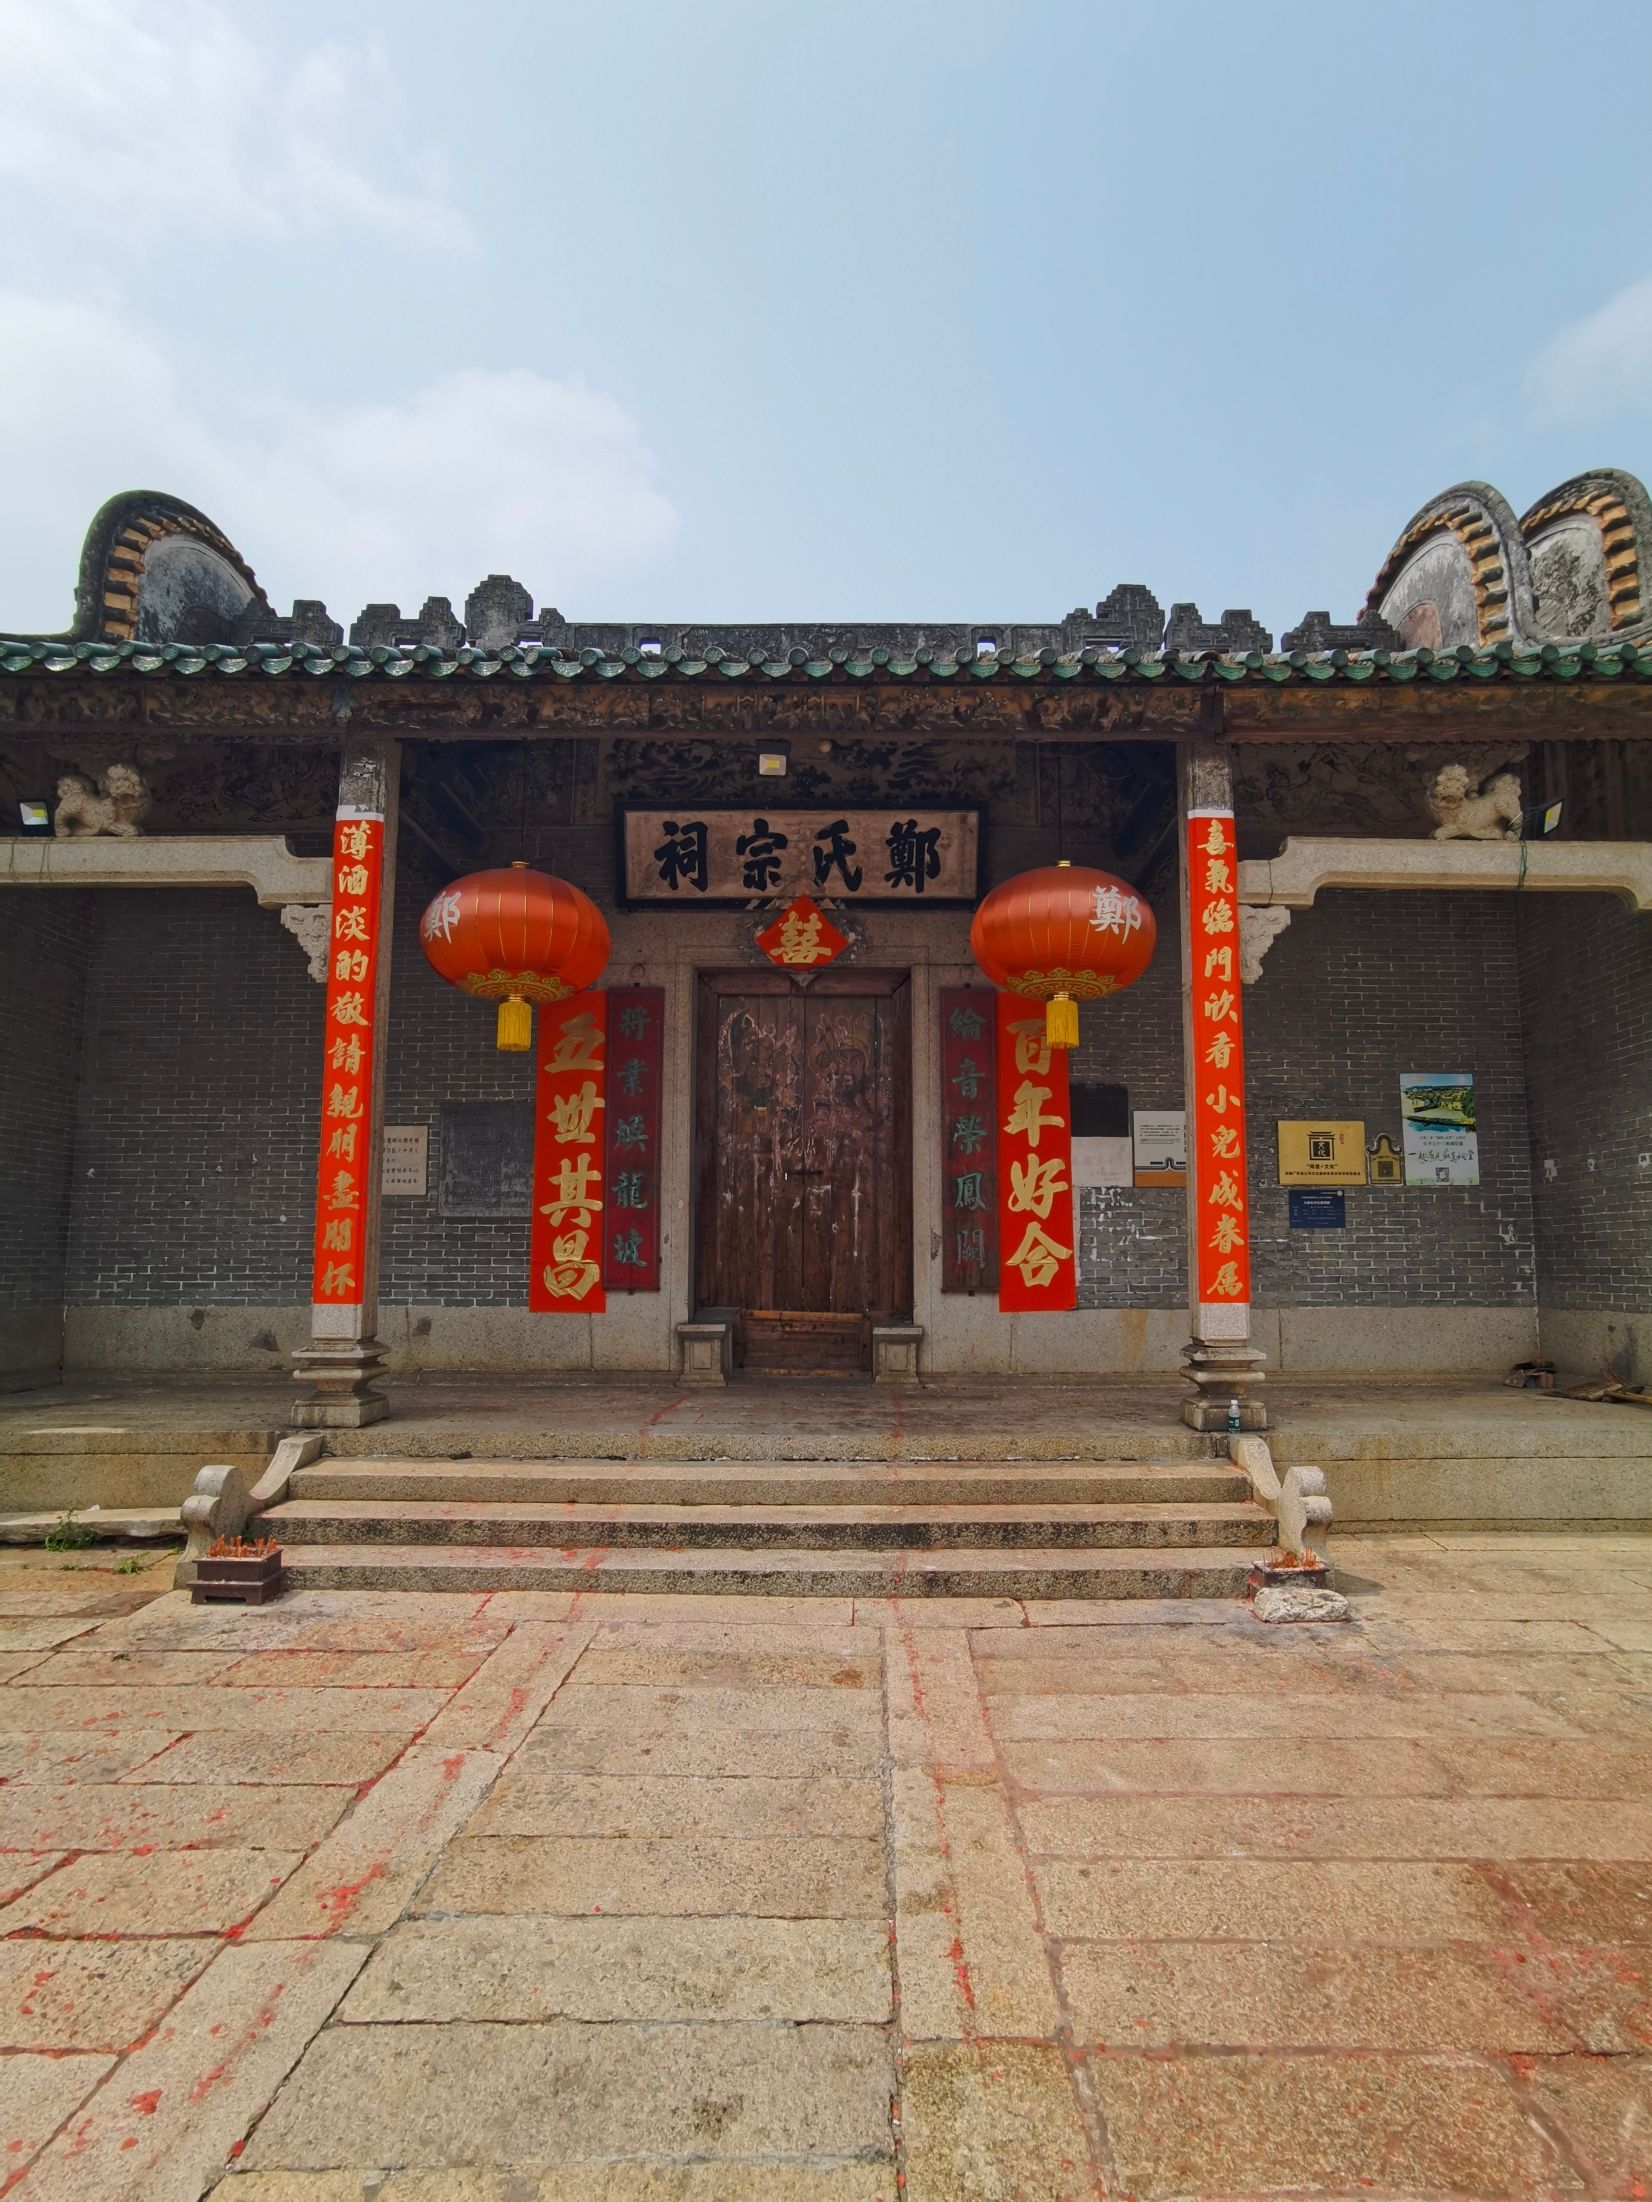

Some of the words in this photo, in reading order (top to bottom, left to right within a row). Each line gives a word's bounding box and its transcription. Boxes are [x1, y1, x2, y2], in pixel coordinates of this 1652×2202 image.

[653, 817, 942, 893] 鄭氏宗祠
[423, 889, 463, 944] 鄭
[1089, 885, 1142, 945] 鄭
[539, 1012, 605, 1302] 五世其昌
[1003, 1018, 1072, 1289] 百年好合
